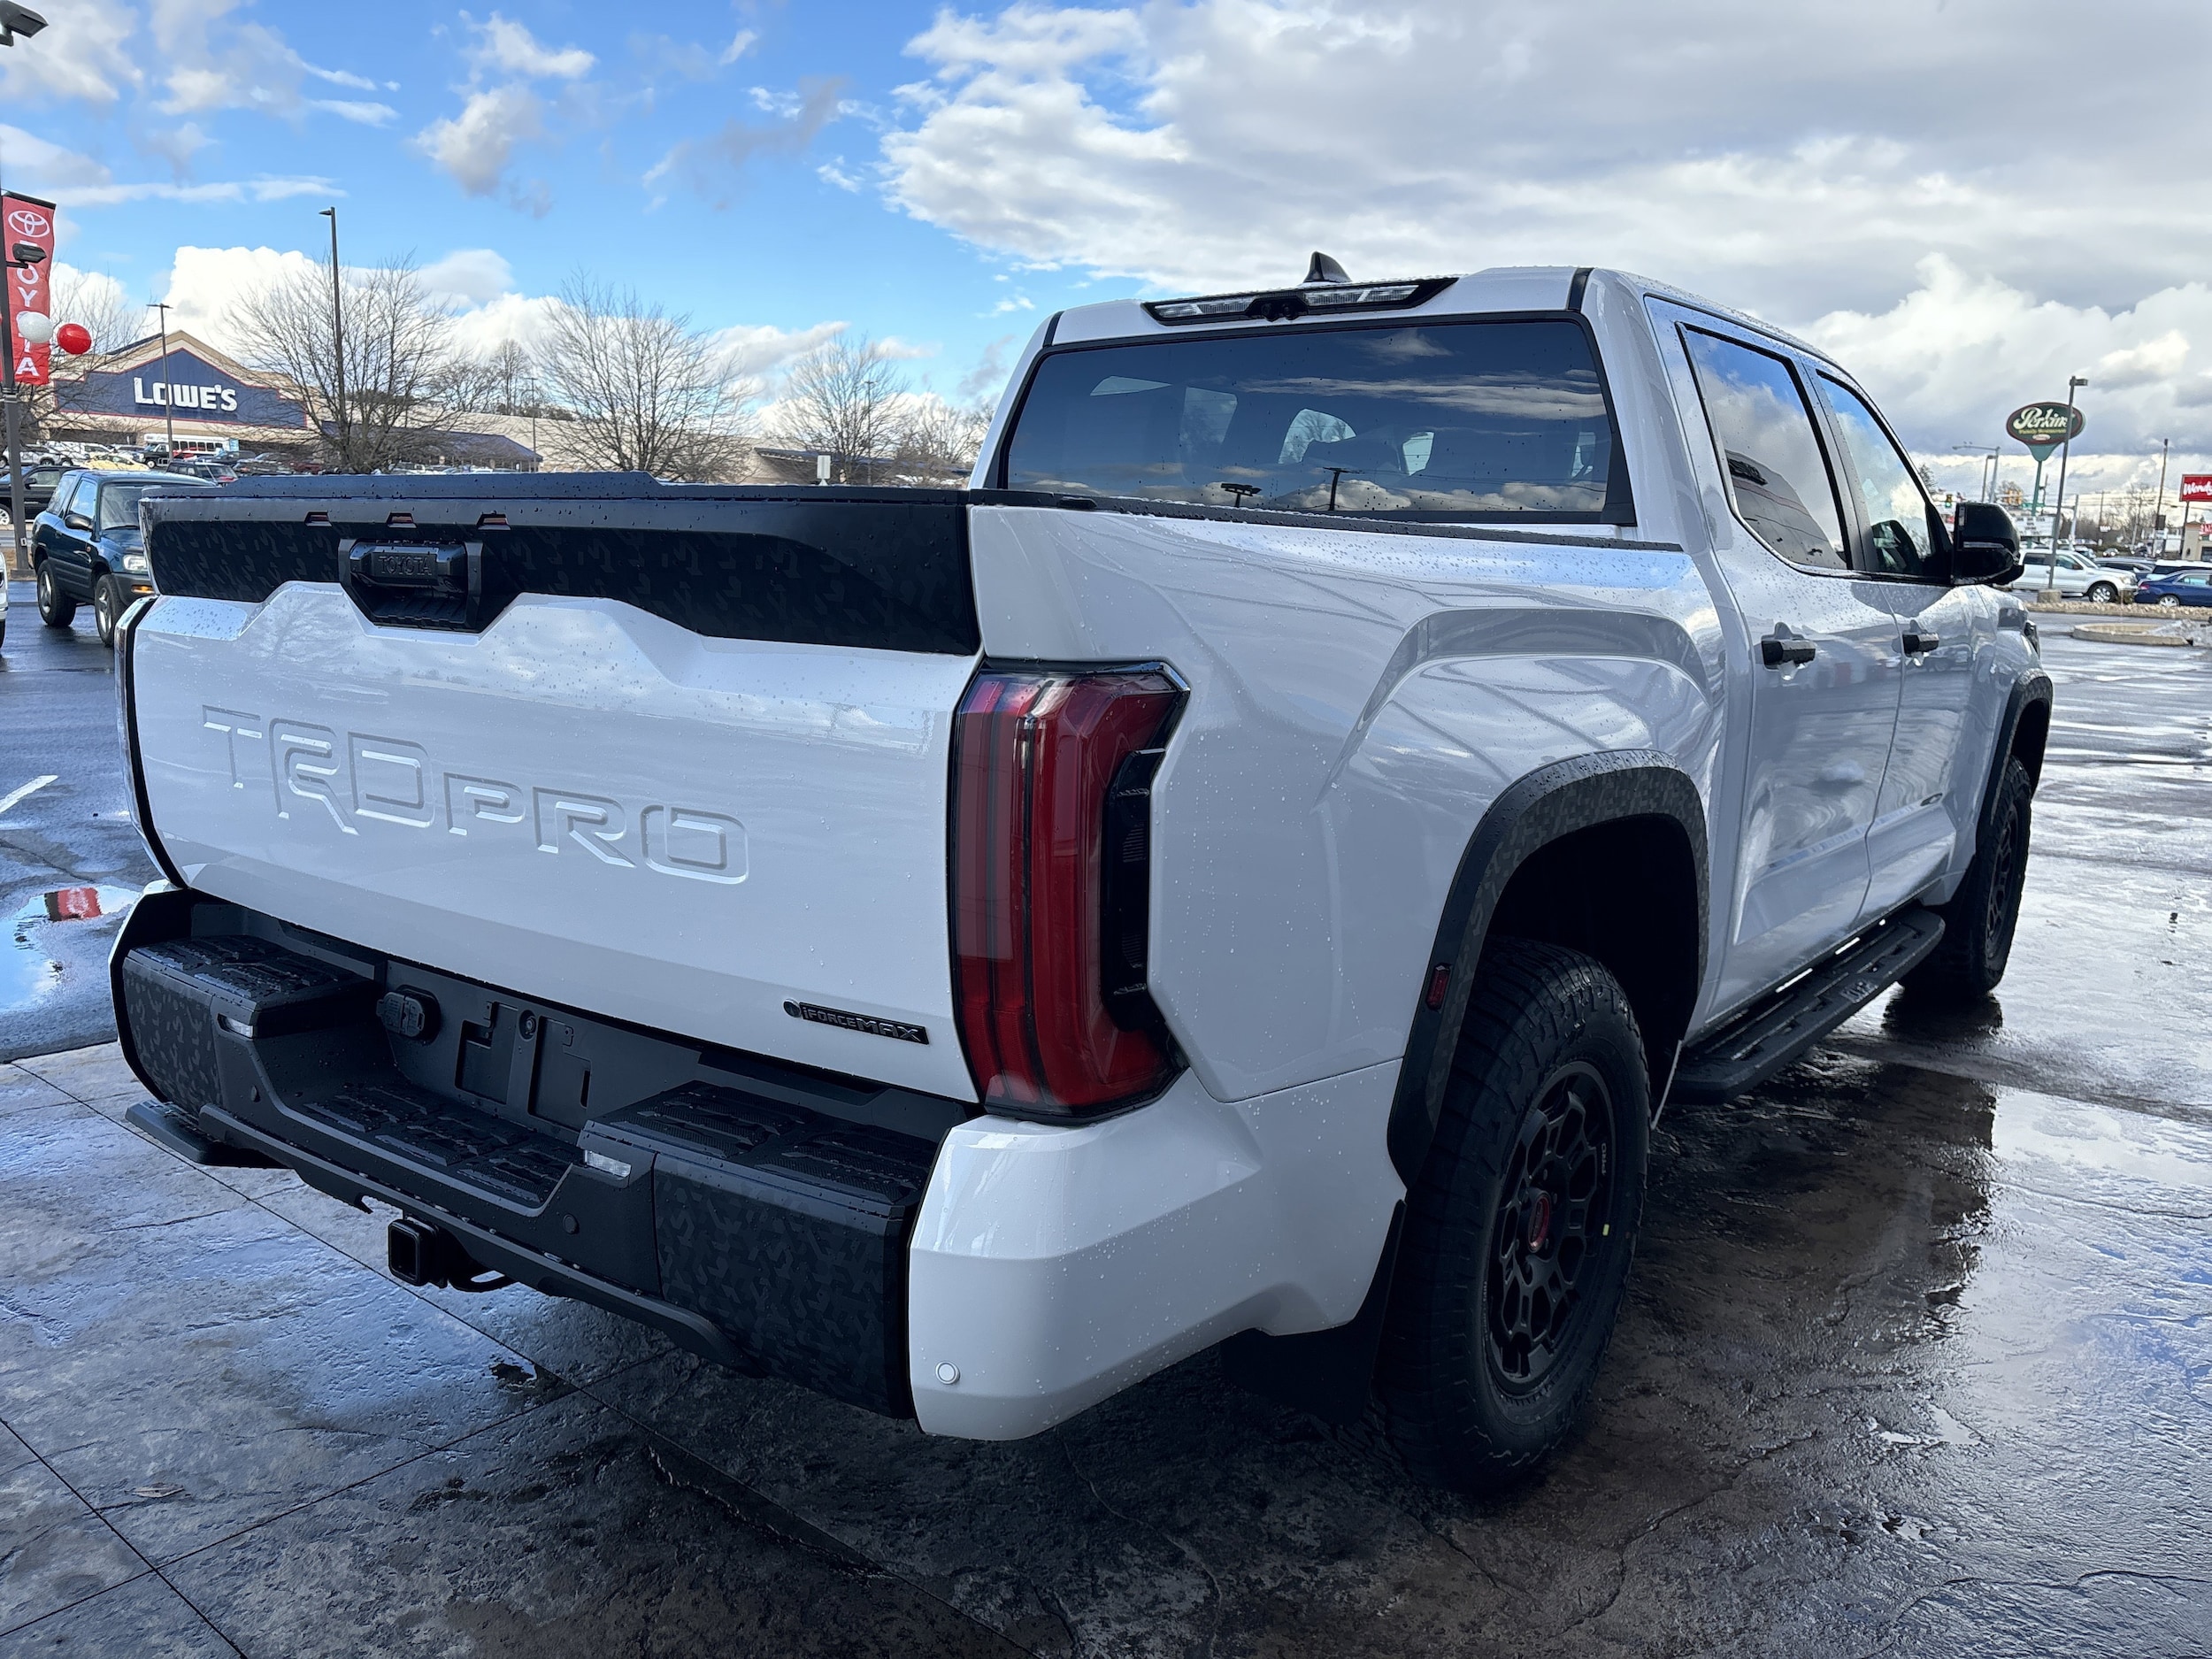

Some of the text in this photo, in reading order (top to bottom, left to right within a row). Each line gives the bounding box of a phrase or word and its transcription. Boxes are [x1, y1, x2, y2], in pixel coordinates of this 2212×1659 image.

[134, 377, 237, 411] LOWE'S
[2013, 407, 2074, 430] Perkin
[379, 556, 433, 576] TOYOTA
